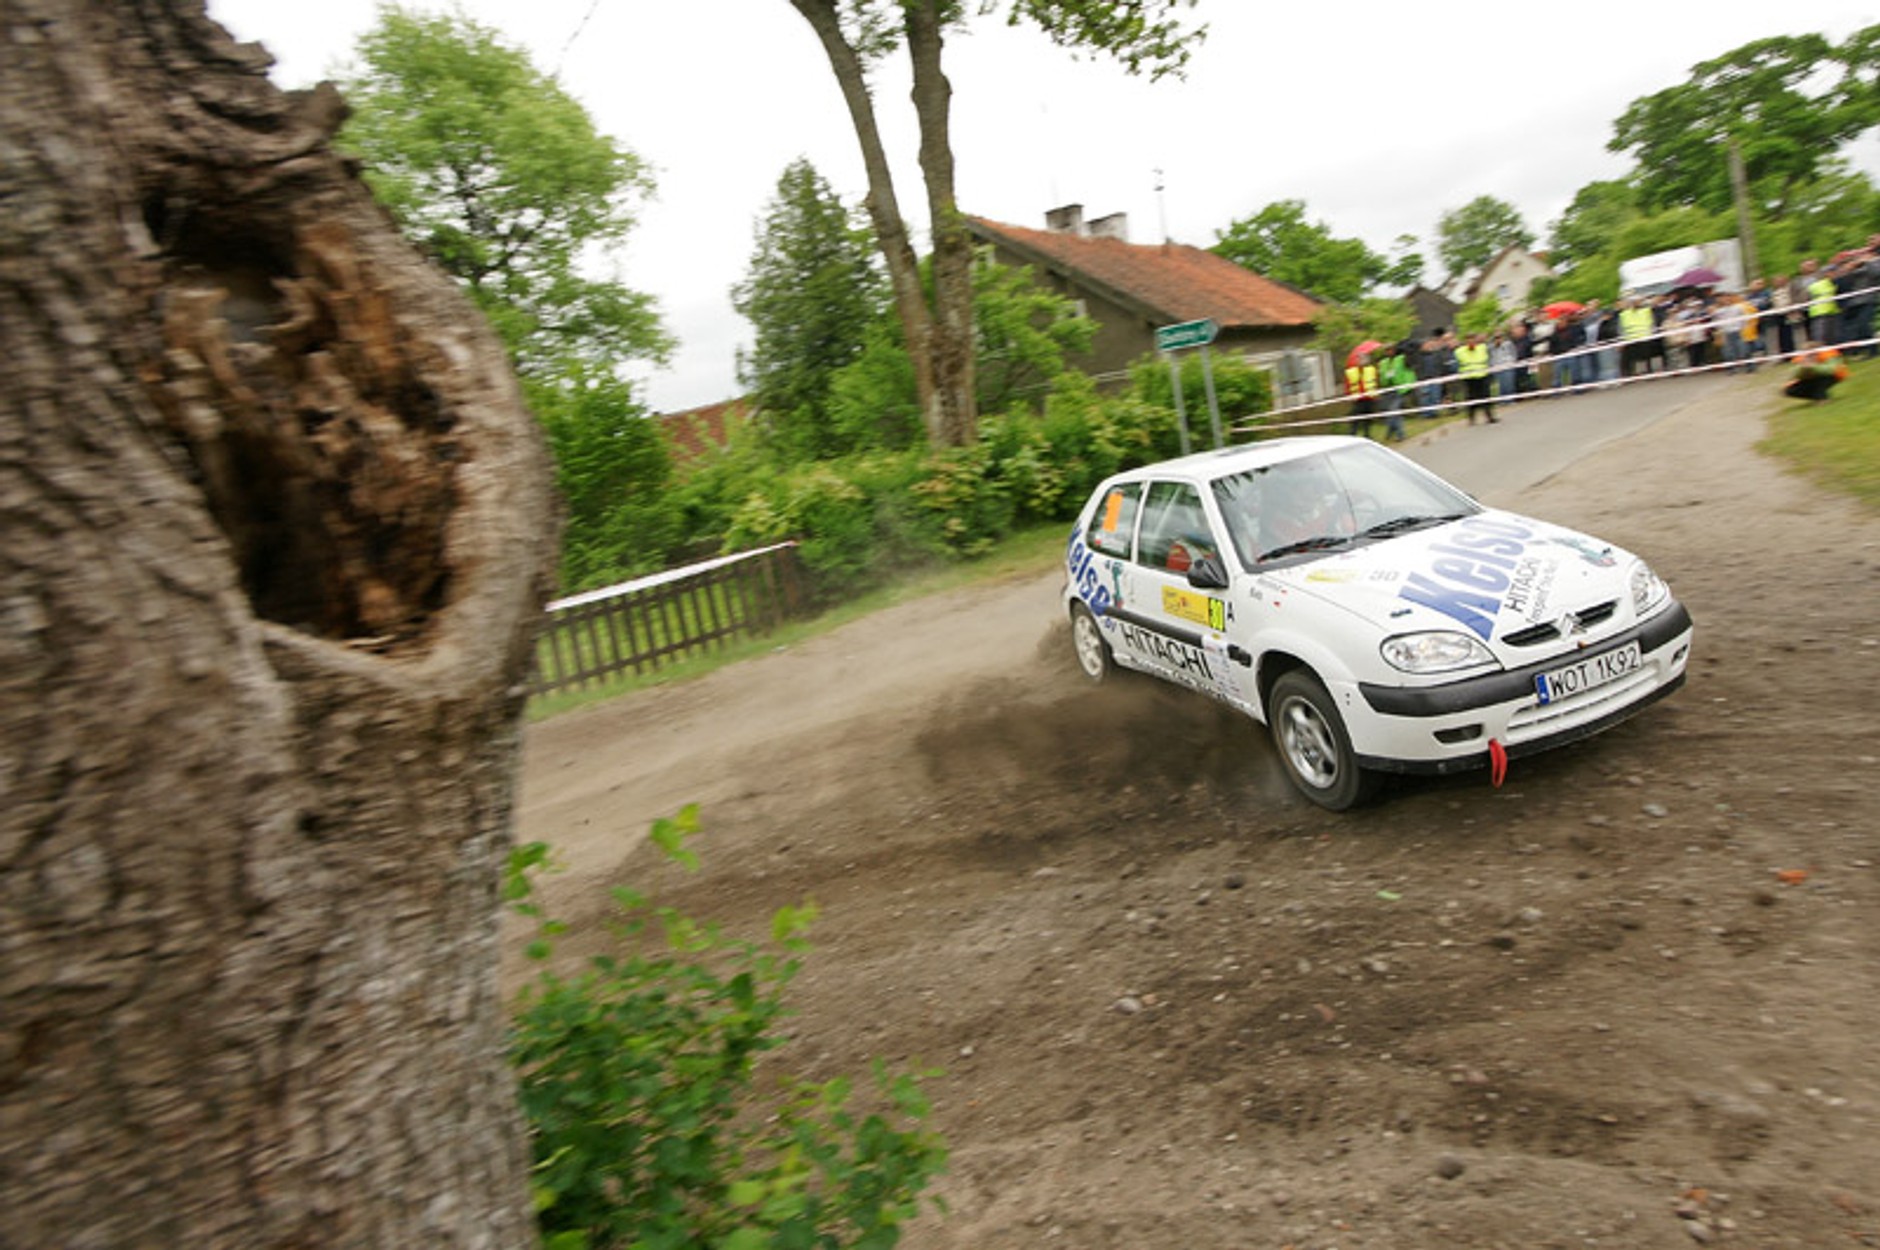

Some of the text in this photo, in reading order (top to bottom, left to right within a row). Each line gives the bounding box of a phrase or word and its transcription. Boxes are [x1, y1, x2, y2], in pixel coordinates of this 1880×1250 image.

[1398, 518, 1533, 642] Kelso
[1120, 622, 1214, 680] HITACHI
[1548, 646, 1639, 697] WOT 1K92
